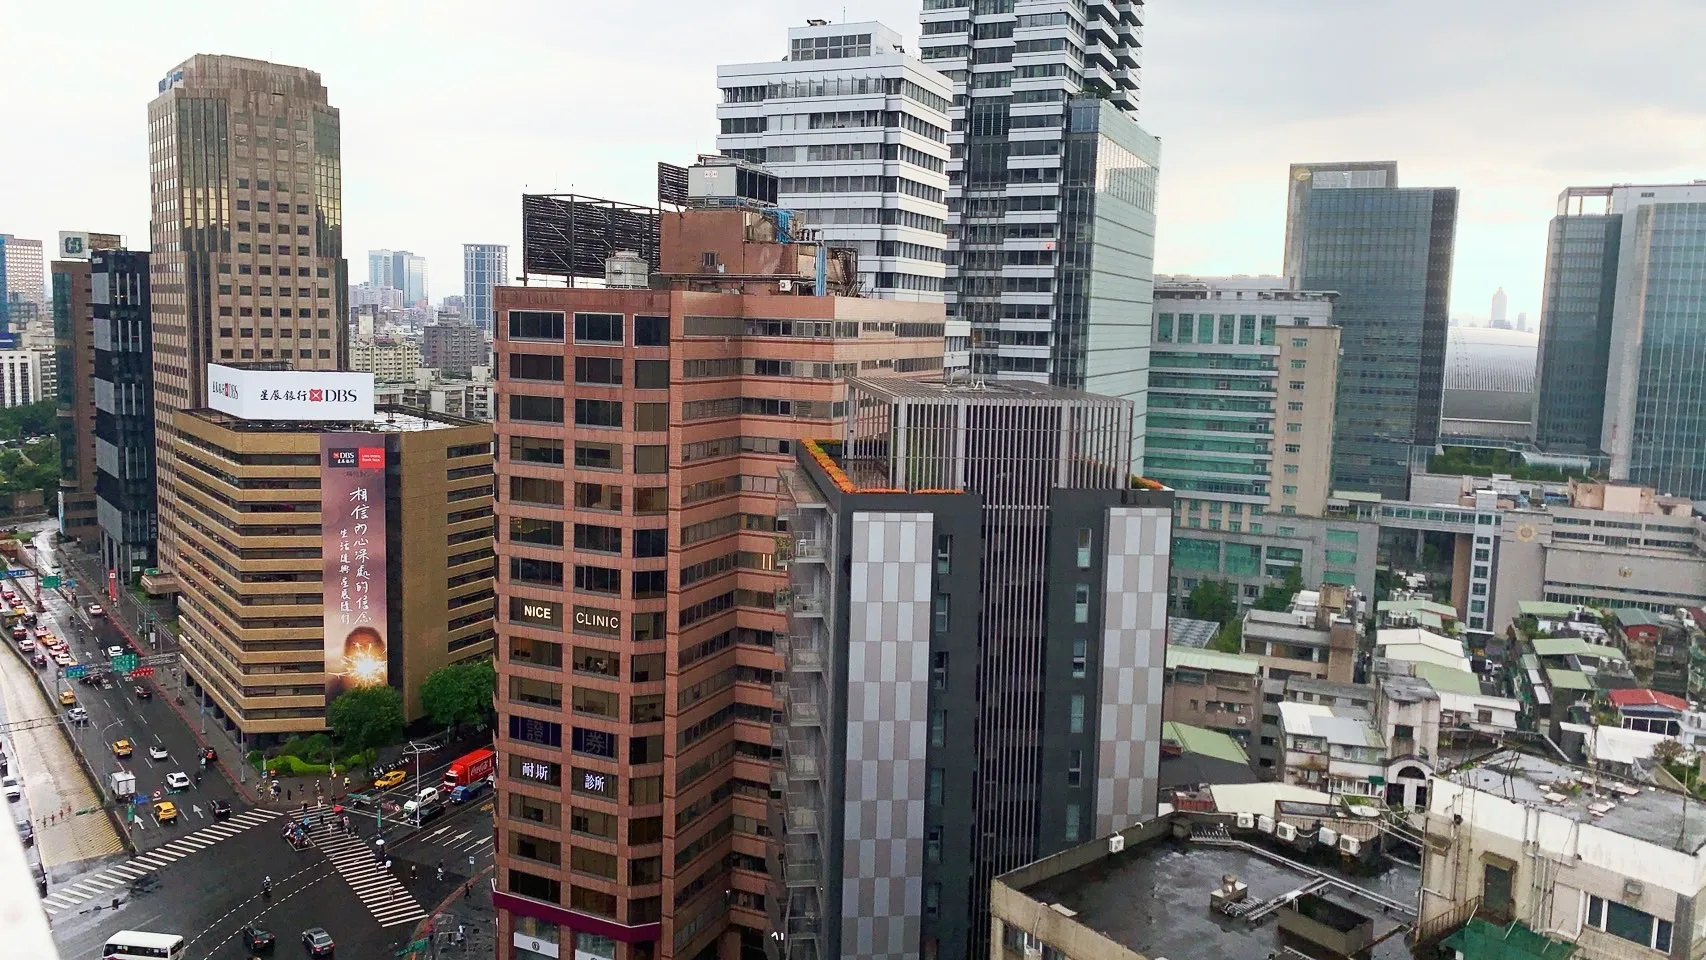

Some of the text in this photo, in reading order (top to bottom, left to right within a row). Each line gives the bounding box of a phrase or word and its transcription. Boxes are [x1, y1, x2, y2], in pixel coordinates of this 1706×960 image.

[325, 389, 357, 403] DBS
[524, 605, 619, 629] NICE CLINIC
[585, 731, 605, 753] 券
[522, 762, 605, 792] 耐斯 診所
